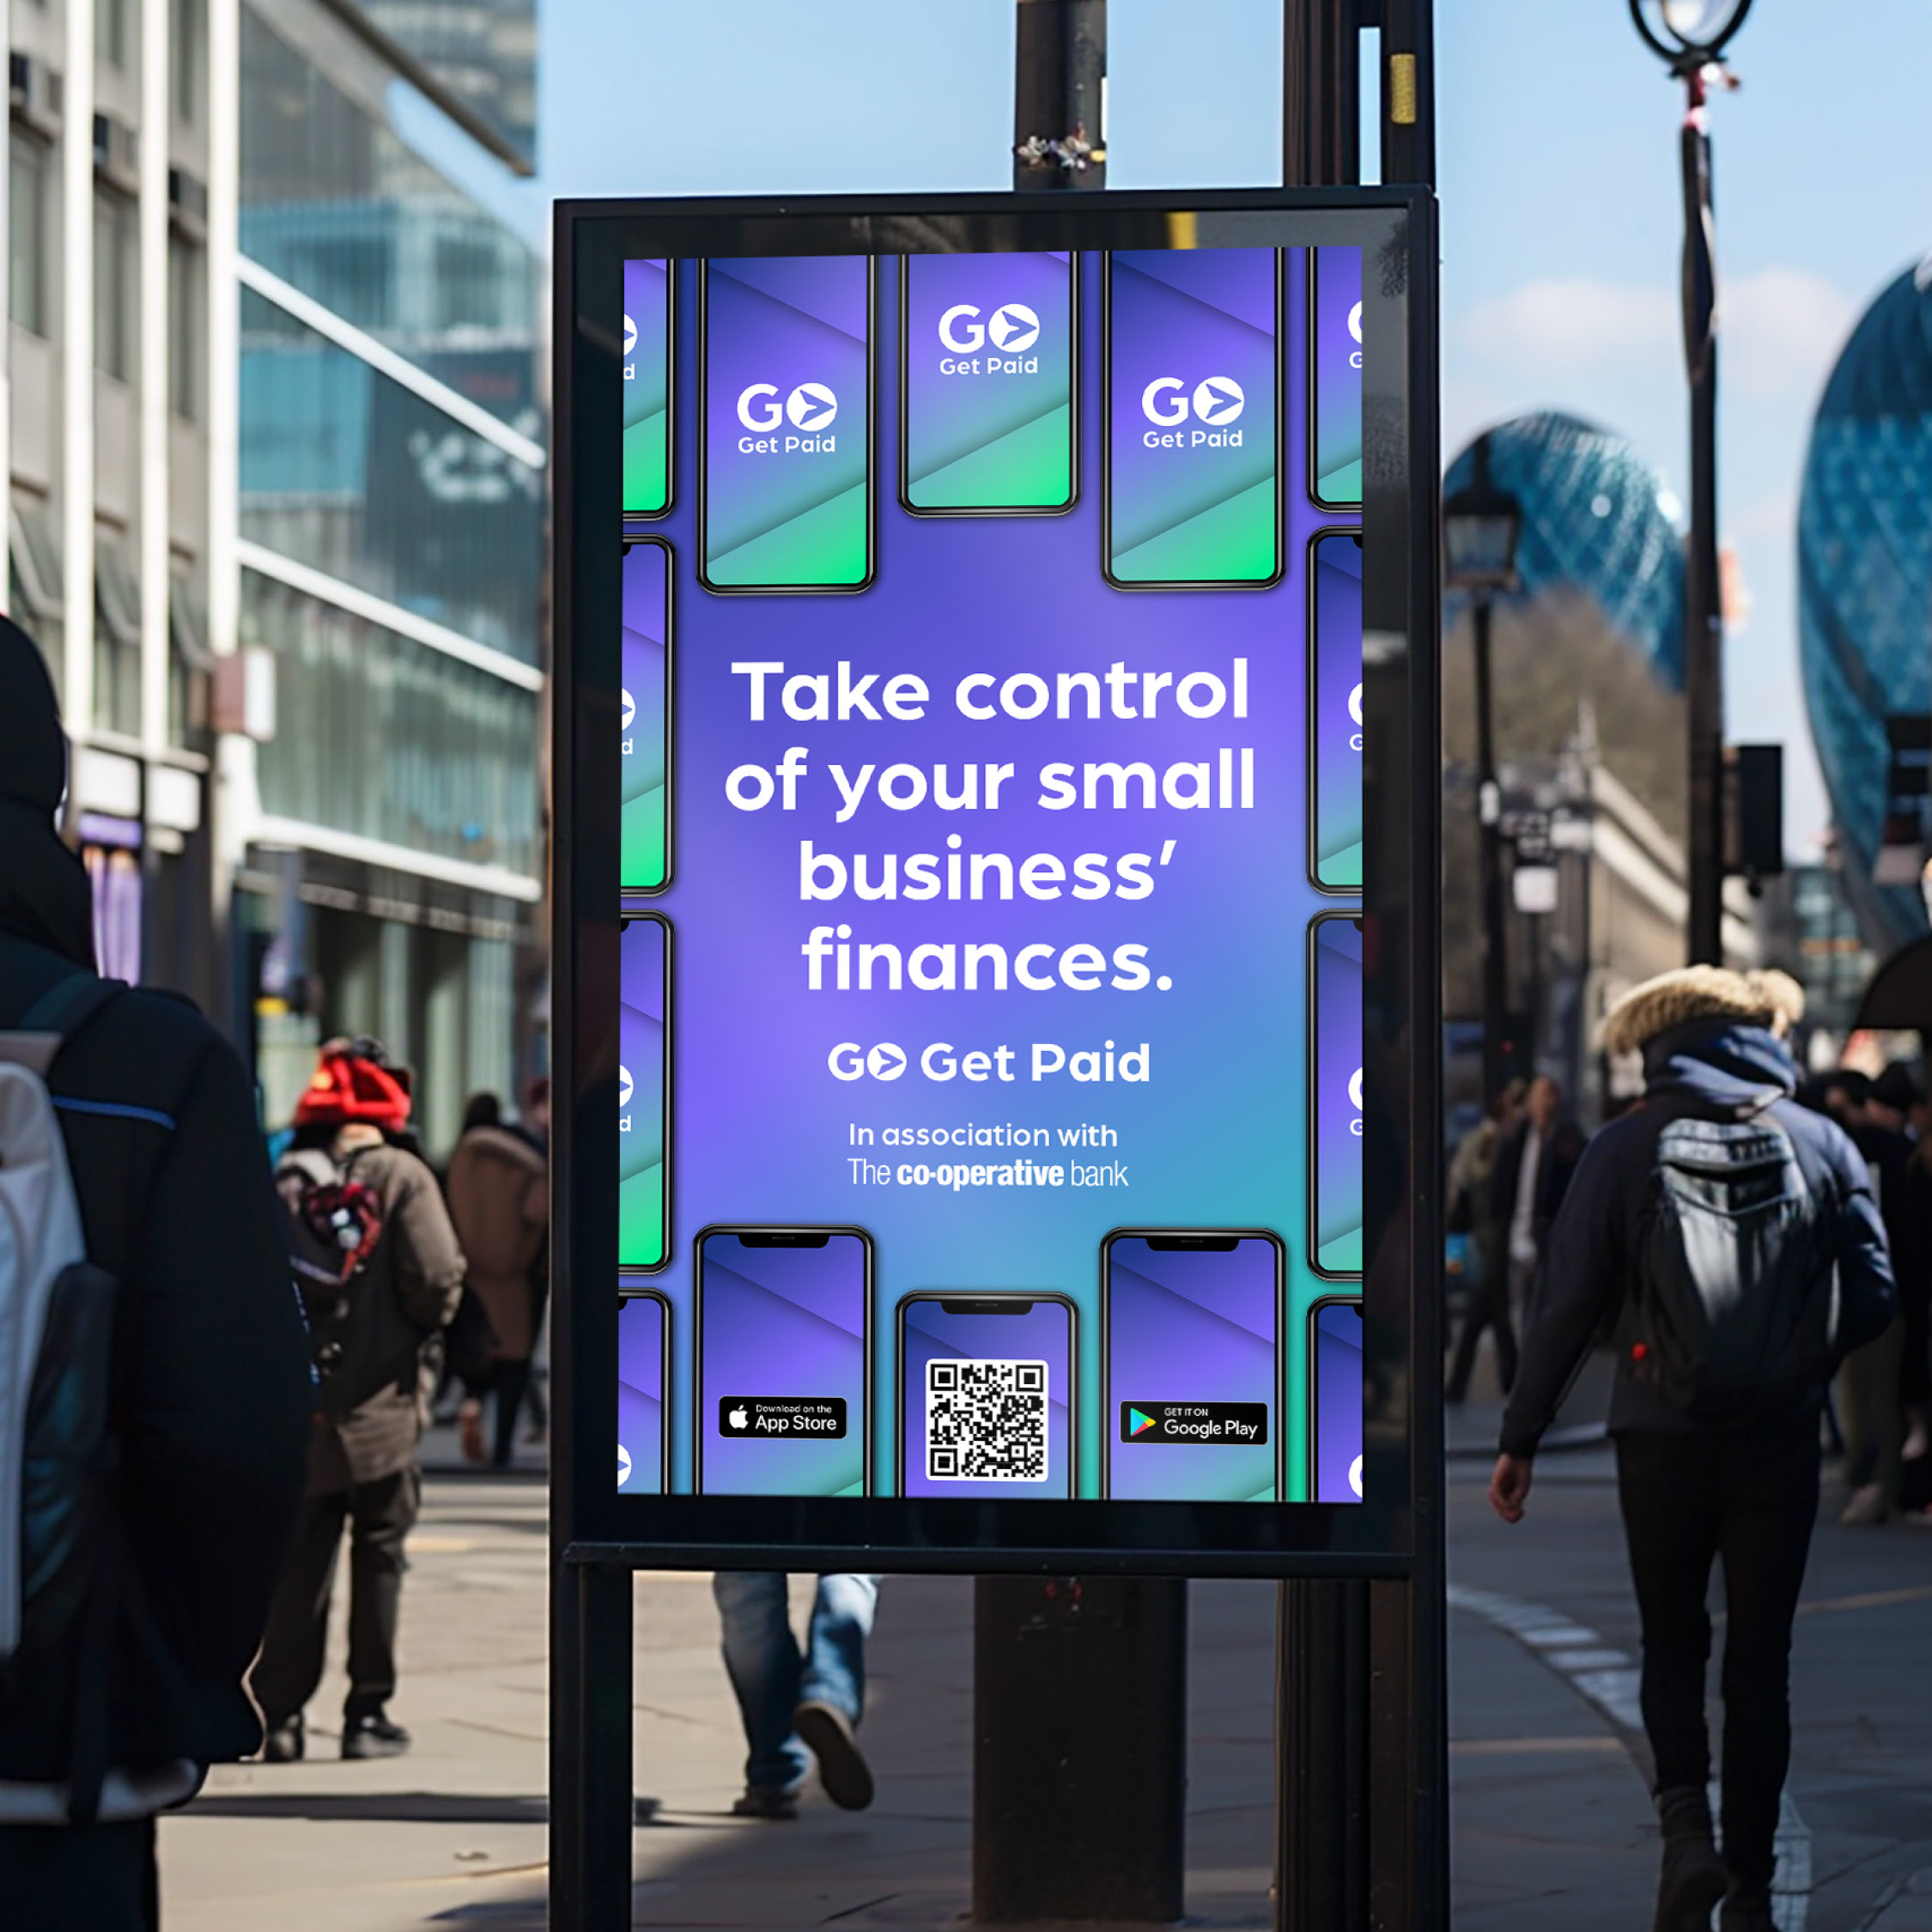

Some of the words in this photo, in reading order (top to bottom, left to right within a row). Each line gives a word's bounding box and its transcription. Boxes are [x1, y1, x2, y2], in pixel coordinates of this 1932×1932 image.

[939, 357, 981, 375] Get
[987, 356, 1039, 374] Paid
[738, 436, 778, 453] Get
[785, 434, 835, 453] Paid
[1143, 431, 1184, 448] Get
[1191, 428, 1243, 447] Paid
[731, 660, 930, 721] Take
[955, 658, 1248, 720] control
[725, 746, 809, 811] of
[828, 762, 1015, 823] your
[1037, 747, 1255, 811] small
[801, 923, 1173, 992] finances.
[920, 1042, 1016, 1082] Get
[1031, 1039, 1150, 1082] Paid
[849, 1123, 874, 1146] In
[881, 1122, 1050, 1147] association
[1056, 1123, 1118, 1147] with
[847, 1157, 890, 1185] The
[896, 1159, 1065, 1192] co-operative
[1070, 1159, 1129, 1187] bank
[755, 1404, 801, 1413] Download
[802, 1405, 815, 1413] on
[817, 1405, 832, 1413] the
[1163, 1407, 1182, 1417] GET
[1184, 1408, 1193, 1417] IT
[1193, 1408, 1208, 1417] ON
[755, 1414, 789, 1433] App
[793, 1415, 837, 1431] Store
[1163, 1419, 1222, 1439] Google
[1224, 1420, 1258, 1440] Play
